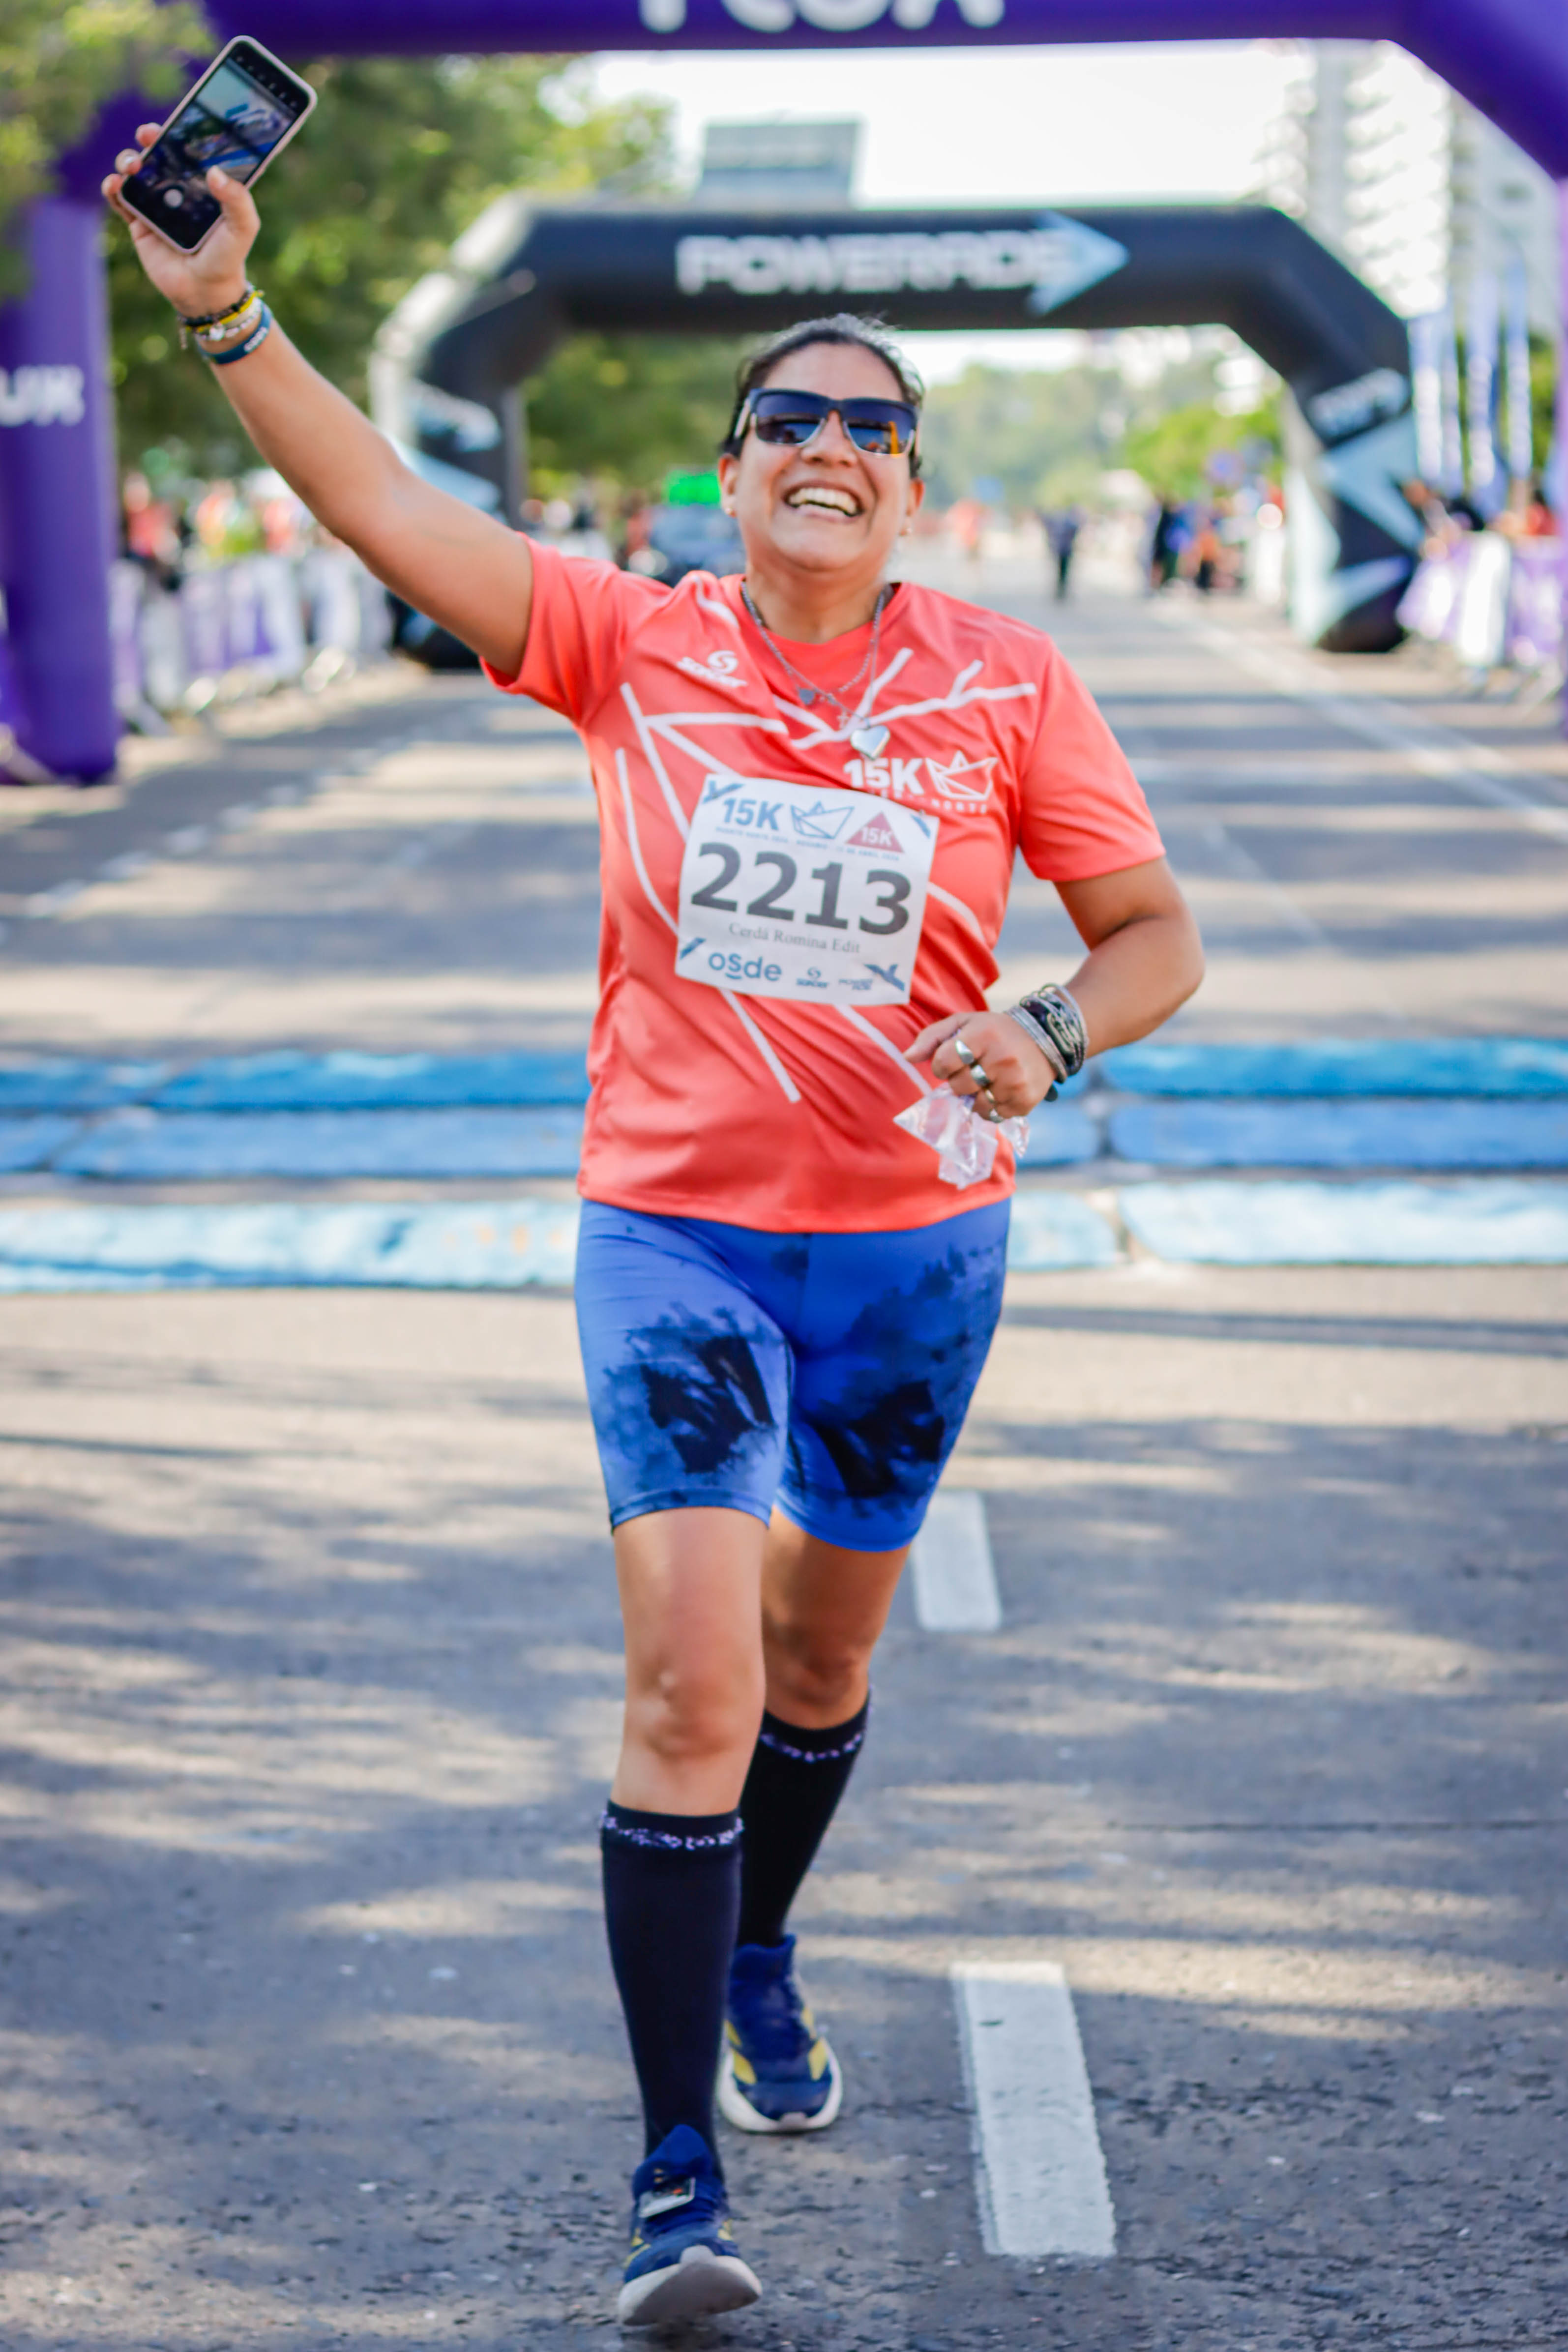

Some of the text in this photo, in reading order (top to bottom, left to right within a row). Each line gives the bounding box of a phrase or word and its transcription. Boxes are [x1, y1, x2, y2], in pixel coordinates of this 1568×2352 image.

[843, 758, 925, 795] 15K
[723, 797, 784, 831] 15K
[861, 827, 893, 846] 15K
[690, 842, 912, 935] 2213
[729, 922, 860, 953] Cerdá Romina Edit
[708, 952, 782, 981] osde
